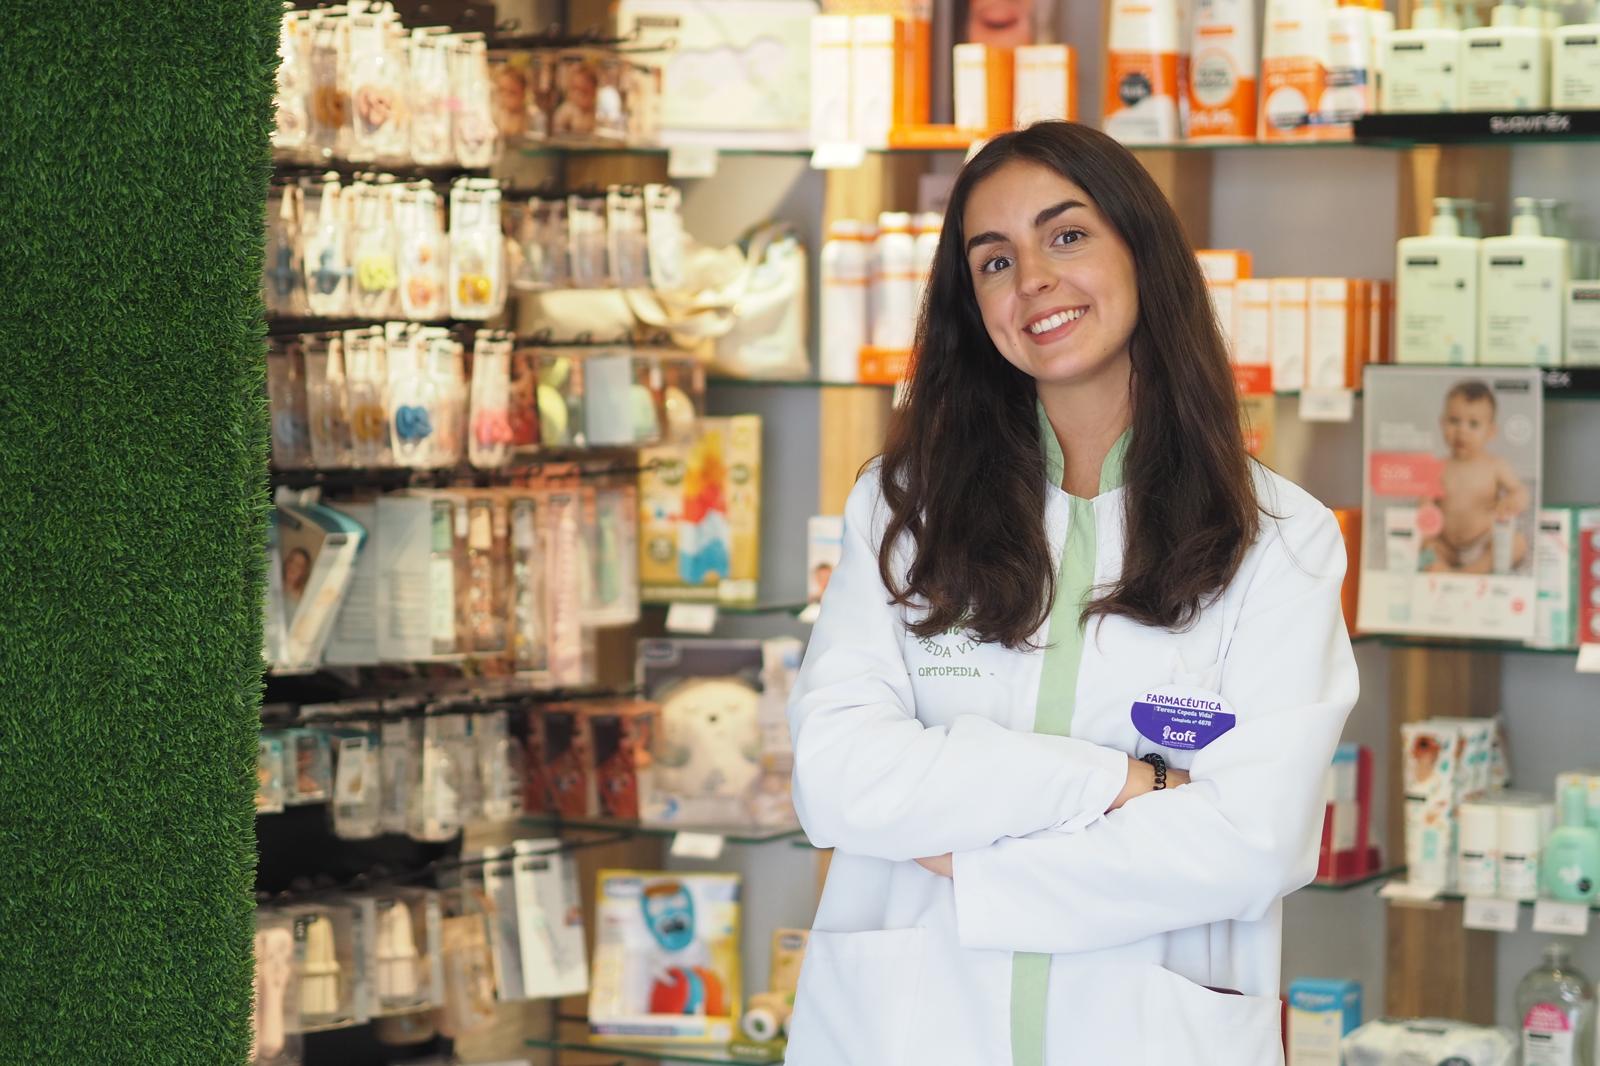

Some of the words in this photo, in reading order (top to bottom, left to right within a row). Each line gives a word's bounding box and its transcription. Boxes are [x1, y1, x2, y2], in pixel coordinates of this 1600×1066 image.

[918, 666, 981, 678] ORTOPEDIA
[1146, 693, 1222, 711] FARMACÉUTICA
[1156, 706, 1176, 714] Teresa
[1177, 708, 1197, 717] Cepeda
[1198, 711, 1213, 719] Vidal
[1170, 730, 1197, 743] cofc
